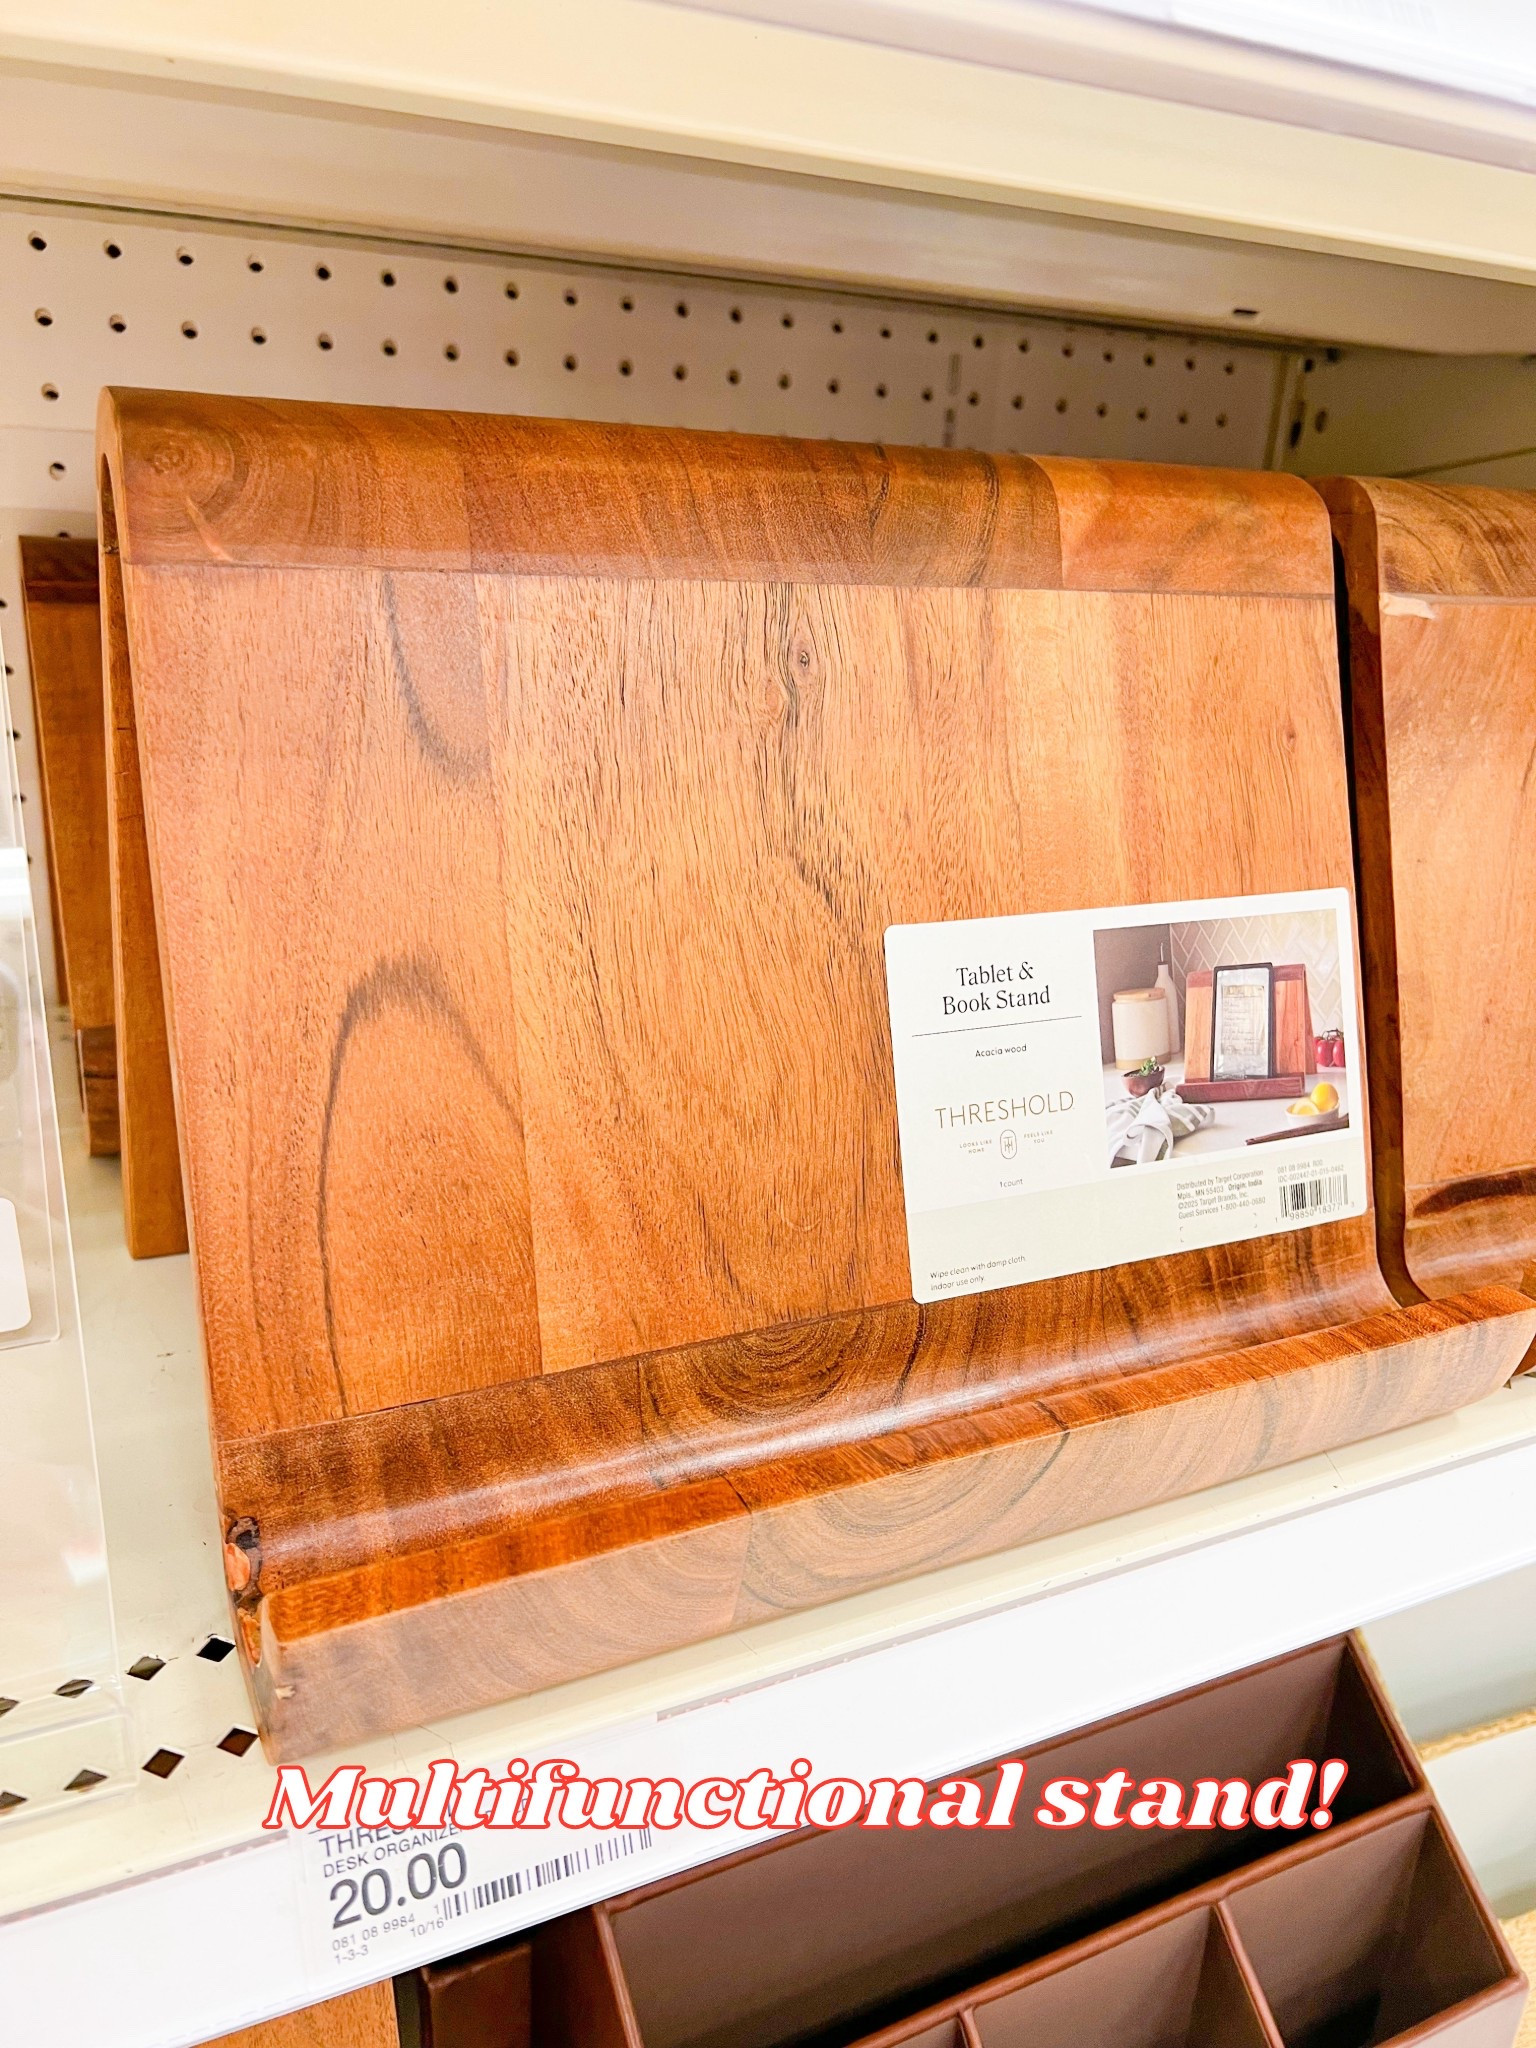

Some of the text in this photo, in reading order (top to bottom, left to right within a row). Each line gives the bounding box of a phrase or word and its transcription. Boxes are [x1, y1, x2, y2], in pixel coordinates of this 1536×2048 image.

[956, 961, 1034, 987] Tablet &
[942, 985, 1050, 1015] Book Stand
[975, 1043, 1027, 1058] Acacia wood
[934, 1090, 1074, 1129] THRESHOLD
[1176, 1169, 1264, 1191] Distributed by Target Corporation
[1199, 1196, 1217, 1206] Target
[929, 1270, 949, 1279] Wipe
[949, 1266, 970, 1276] clean
[970, 1262, 986, 1271] with
[986, 1258, 1008, 1269] damp
[956, 1279, 969, 1287] use
[323, 1823, 463, 1878] DESK ORGANIZE
[329, 1842, 468, 1930] 20.00
[332, 1933, 357, 1952] 081
[361, 1927, 380, 1942] 08
[382, 1913, 415, 1935] 9984
[334, 1919, 445, 1965] 1-3-3 10/16
